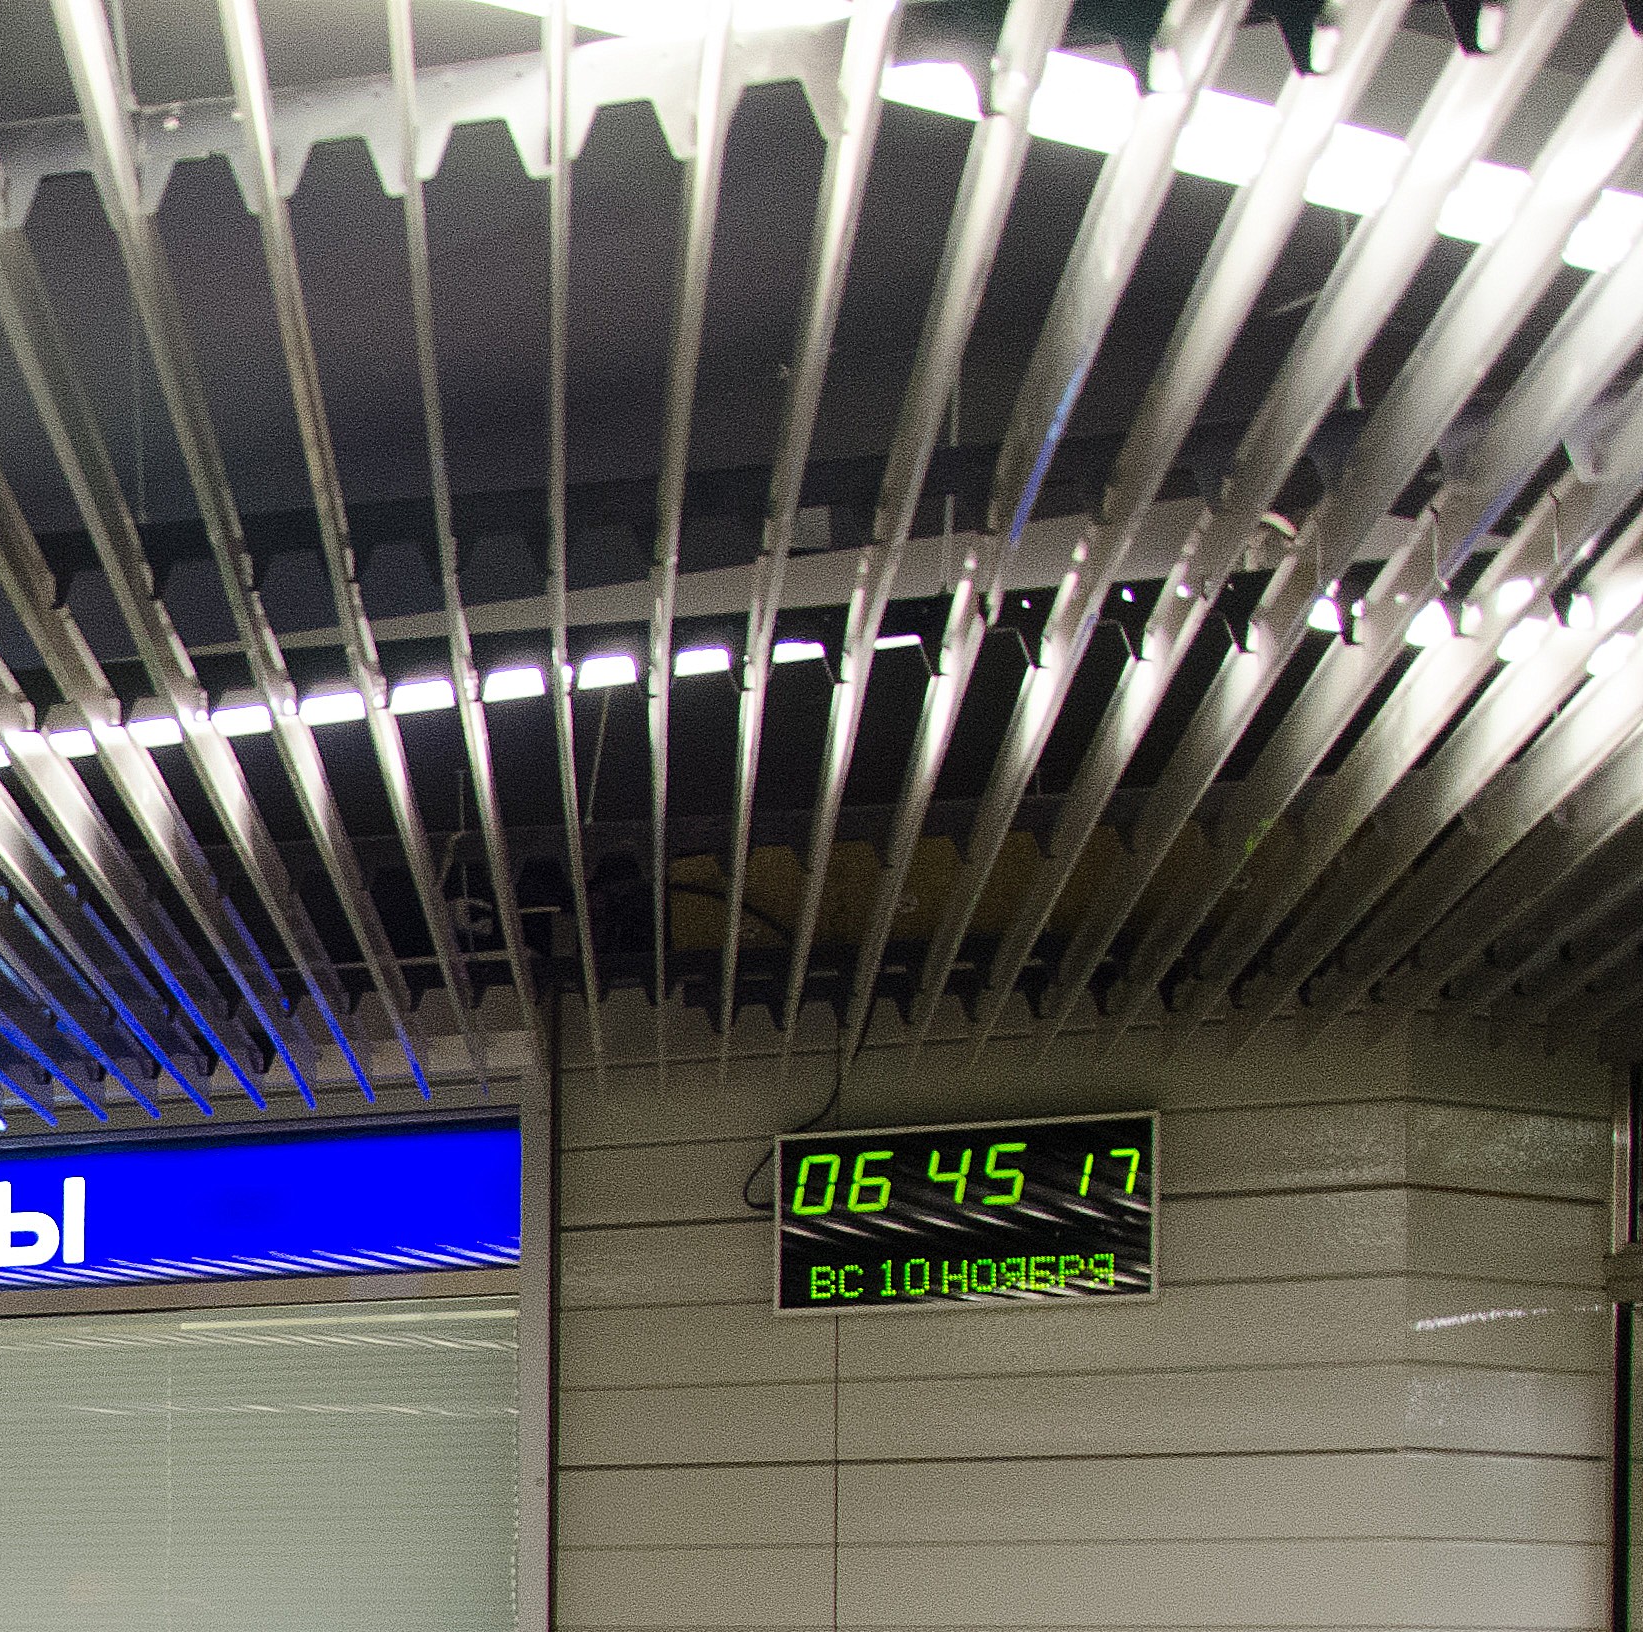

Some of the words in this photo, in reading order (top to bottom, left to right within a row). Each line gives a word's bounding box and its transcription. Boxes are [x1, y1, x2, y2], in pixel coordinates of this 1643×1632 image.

[792, 1150, 894, 1215] 06
[928, 1142, 1027, 1205] 45
[1079, 1148, 1141, 1197] 17
[810, 1264, 864, 1300] ВС
[880, 1258, 930, 1297] 10
[941, 1253, 1115, 1294] НОЯБРЯ
